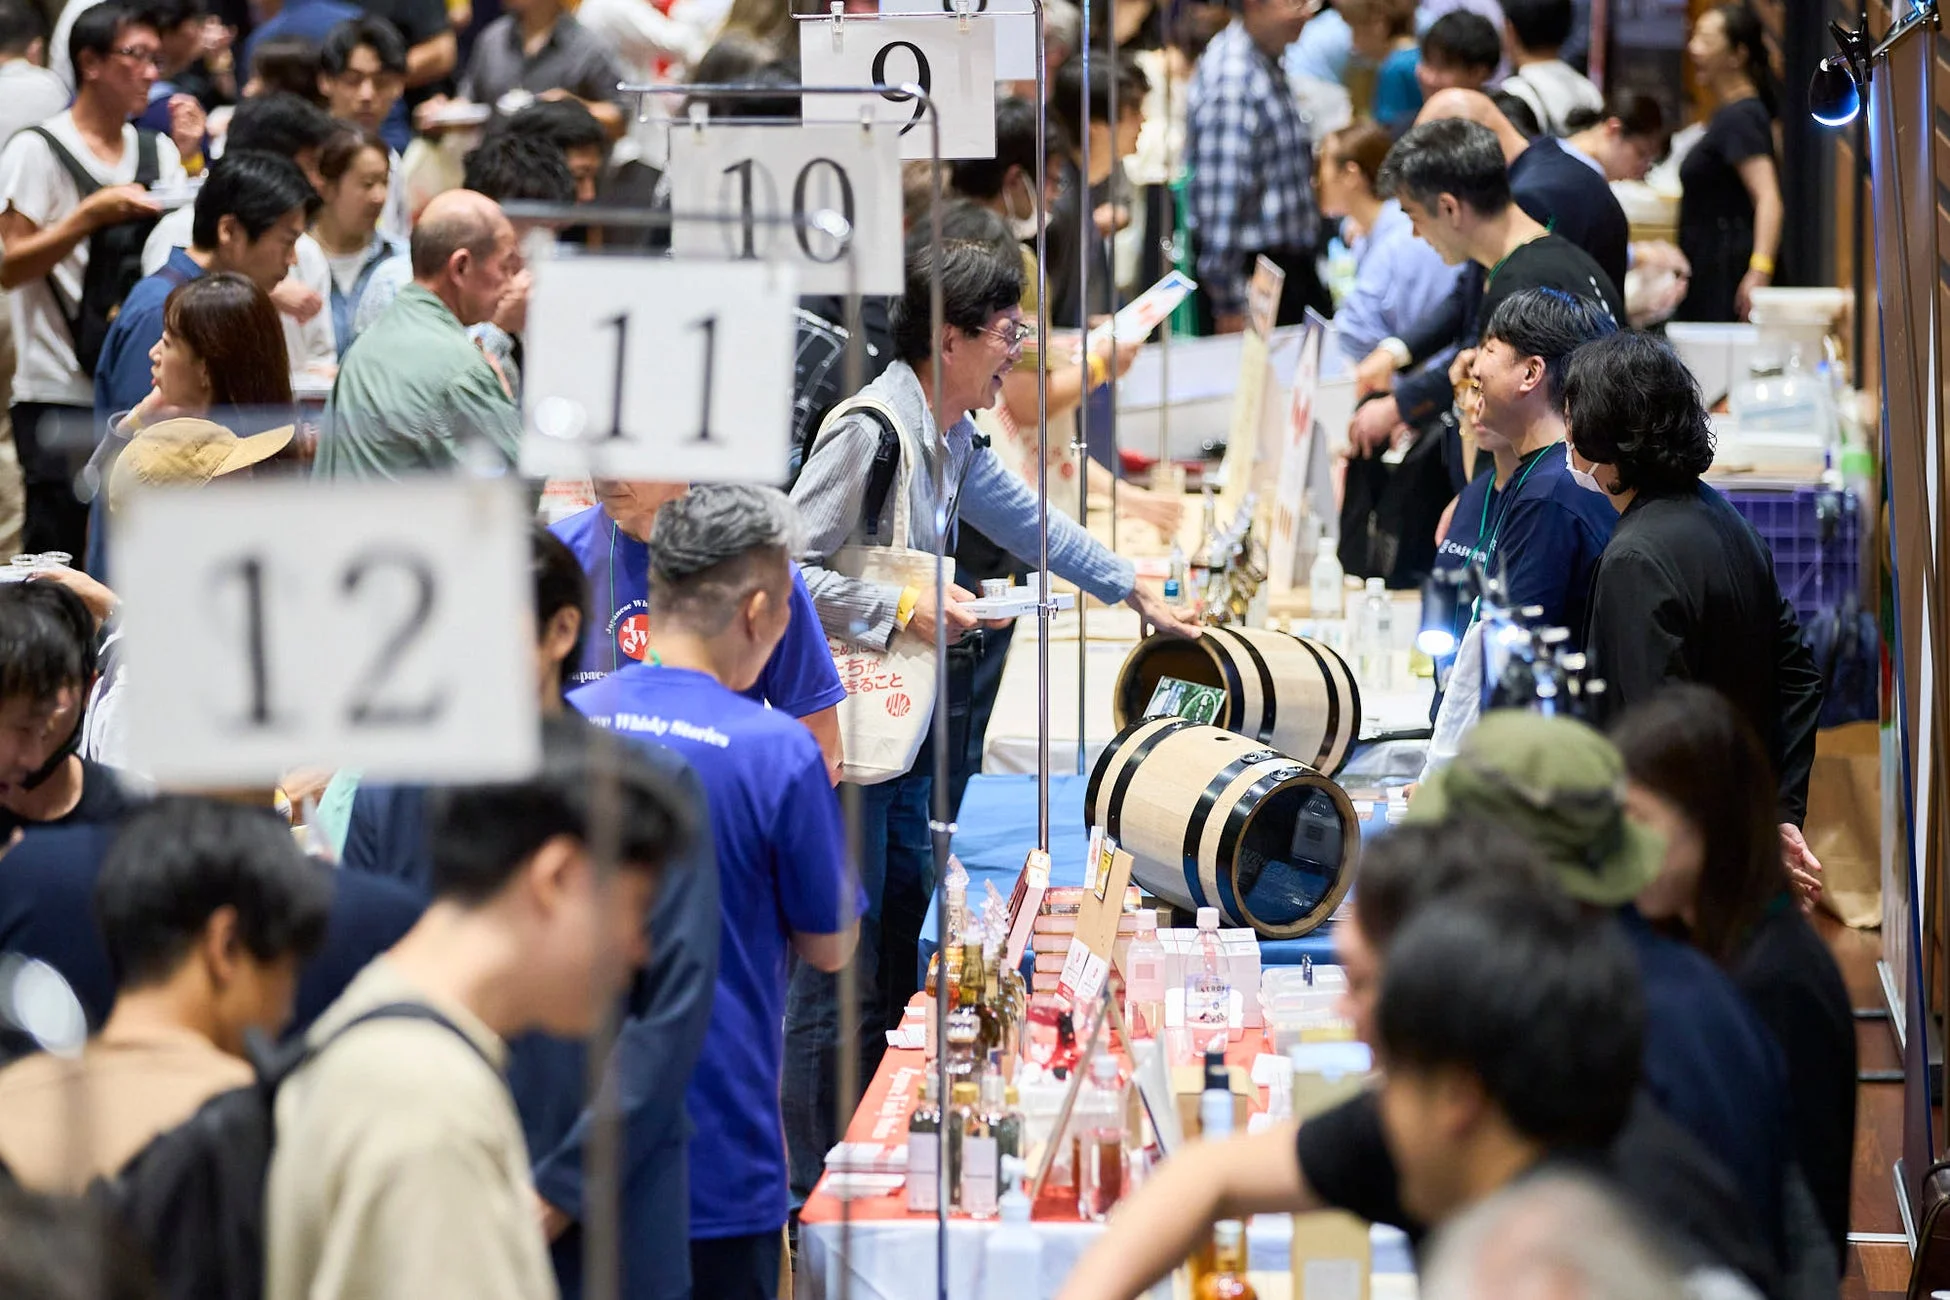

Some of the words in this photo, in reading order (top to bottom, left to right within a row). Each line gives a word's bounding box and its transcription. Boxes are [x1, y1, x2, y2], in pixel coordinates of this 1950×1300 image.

[872, 41, 931, 137] 9
[722, 157, 855, 263] 10
[593, 312, 728, 446] 11
[203, 545, 456, 737] 12
[837, 658, 881, 678] ちが
[615, 712, 669, 737] Whisky
